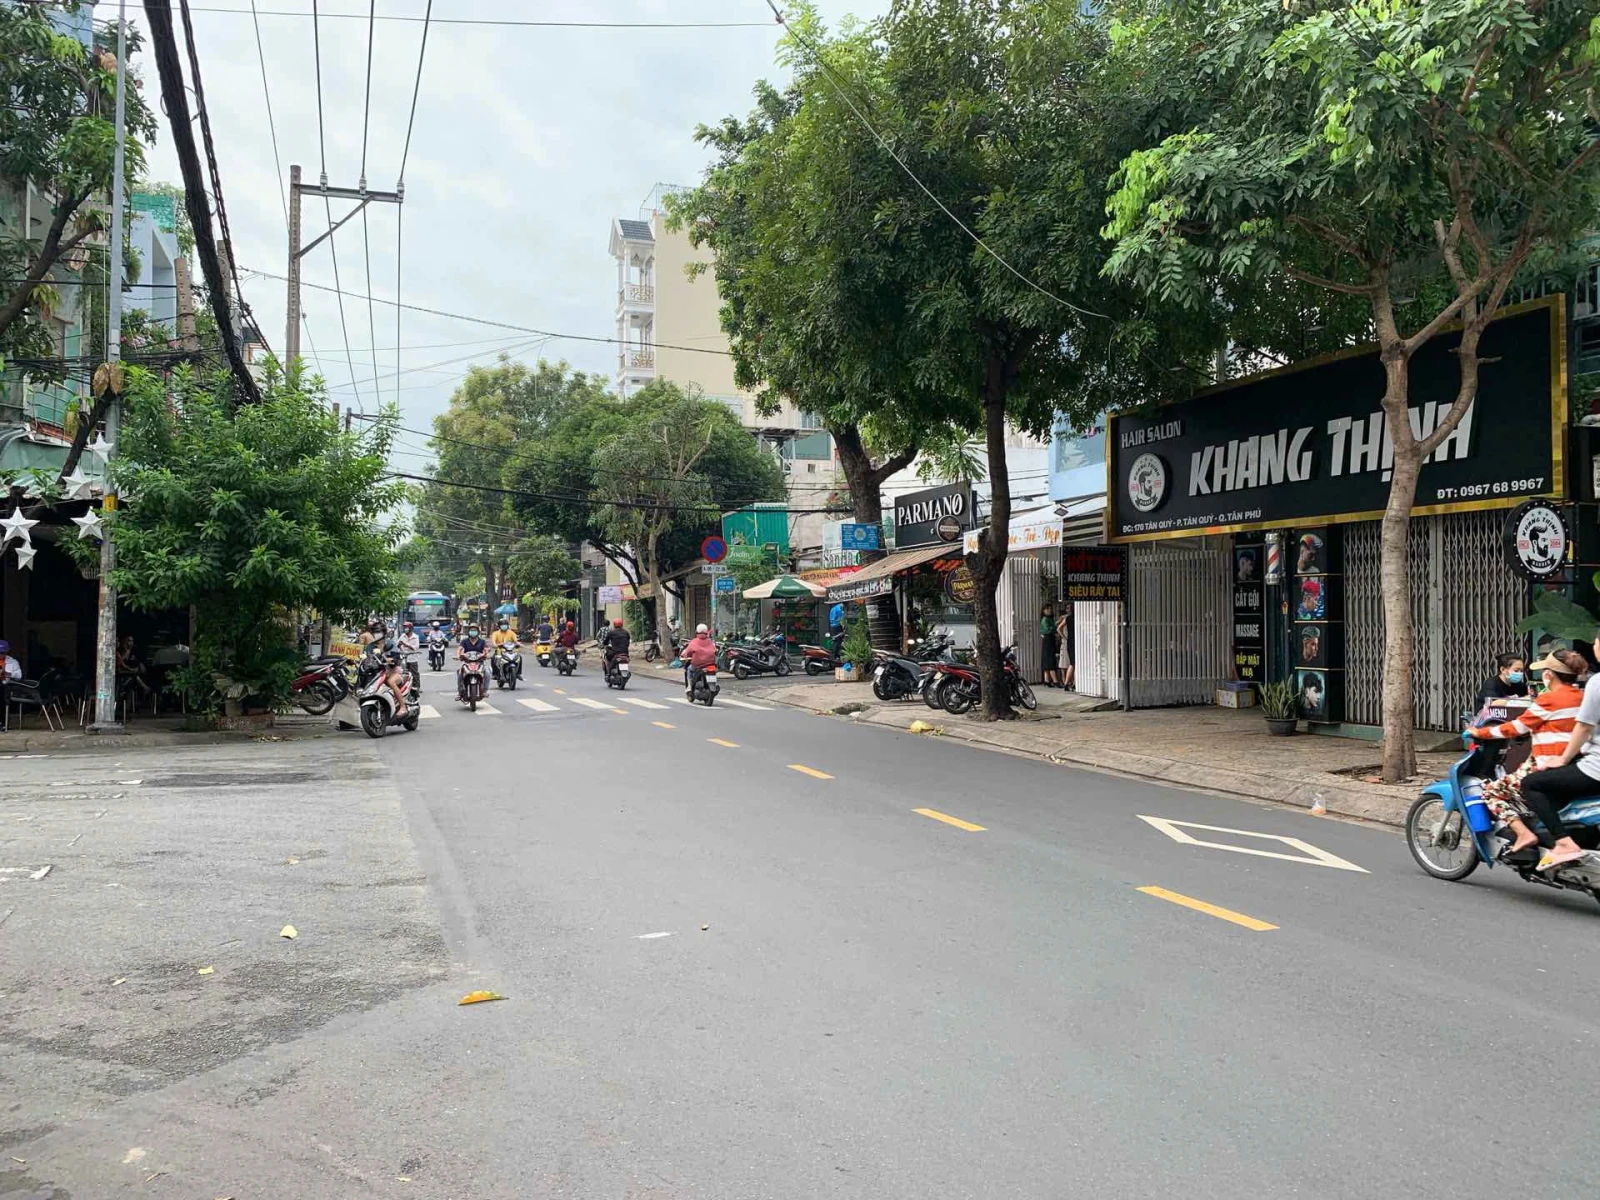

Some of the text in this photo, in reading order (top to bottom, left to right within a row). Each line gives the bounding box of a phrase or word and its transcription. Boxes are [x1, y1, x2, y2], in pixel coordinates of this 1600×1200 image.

[1121, 420, 1181, 448] HAIR SALON
[1189, 426, 1314, 497] KHANG
[1460, 483, 1490, 497] 0967
[1493, 481, 1509, 493] 68
[1511, 477, 1544, 491] 9967
[1107, 586, 1120, 597] TAI
[1236, 624, 1259, 637] MASSAGE
